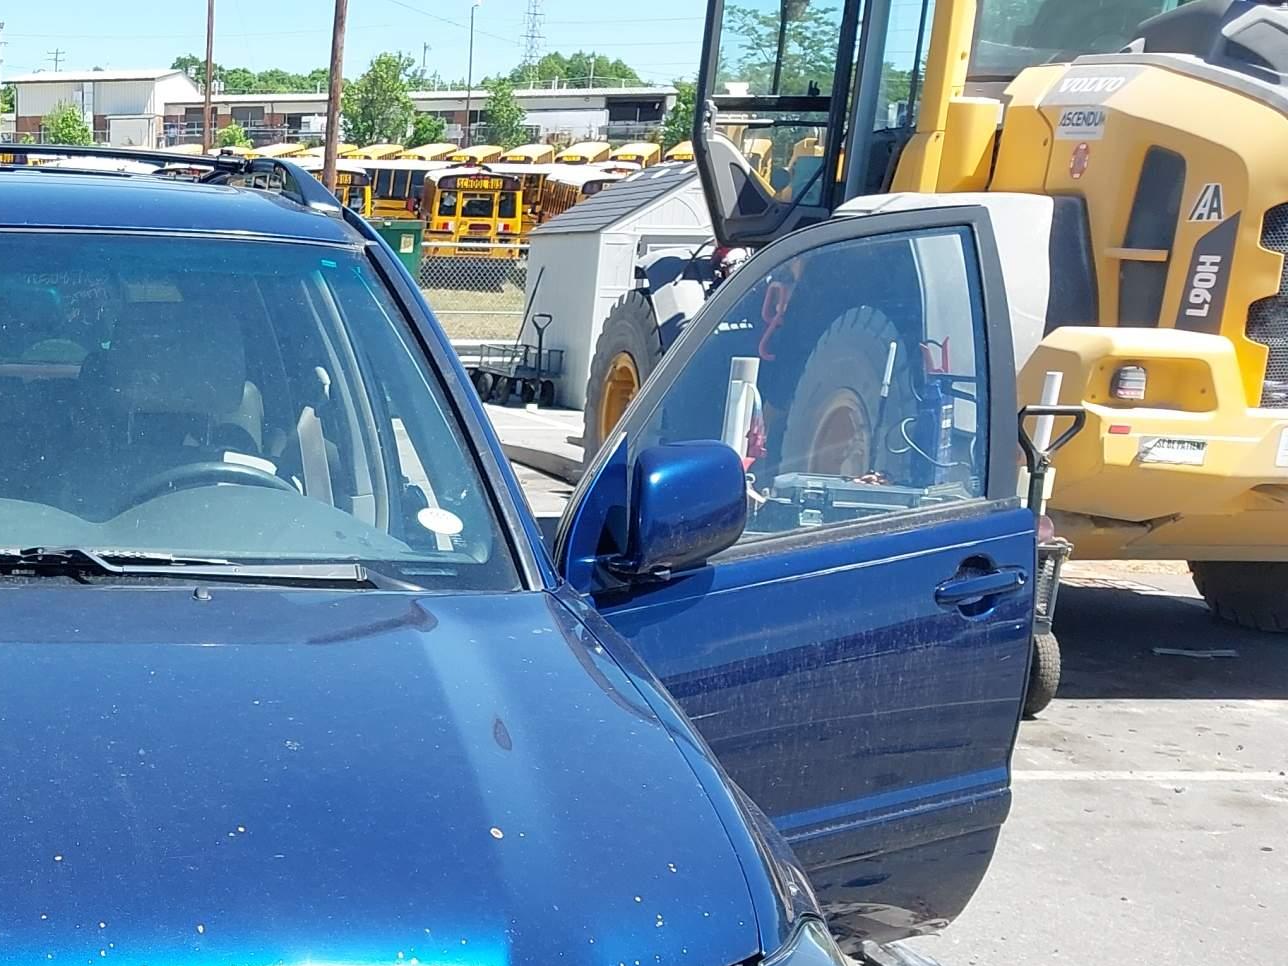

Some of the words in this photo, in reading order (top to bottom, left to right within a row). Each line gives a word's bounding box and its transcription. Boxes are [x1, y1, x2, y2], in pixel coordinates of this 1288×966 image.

[1059, 77, 1126, 93] VOLVO
[457, 178, 488, 189] SCHOOL
[489, 178, 504, 189] BUS
[1185, 255, 1222, 317] L90H
